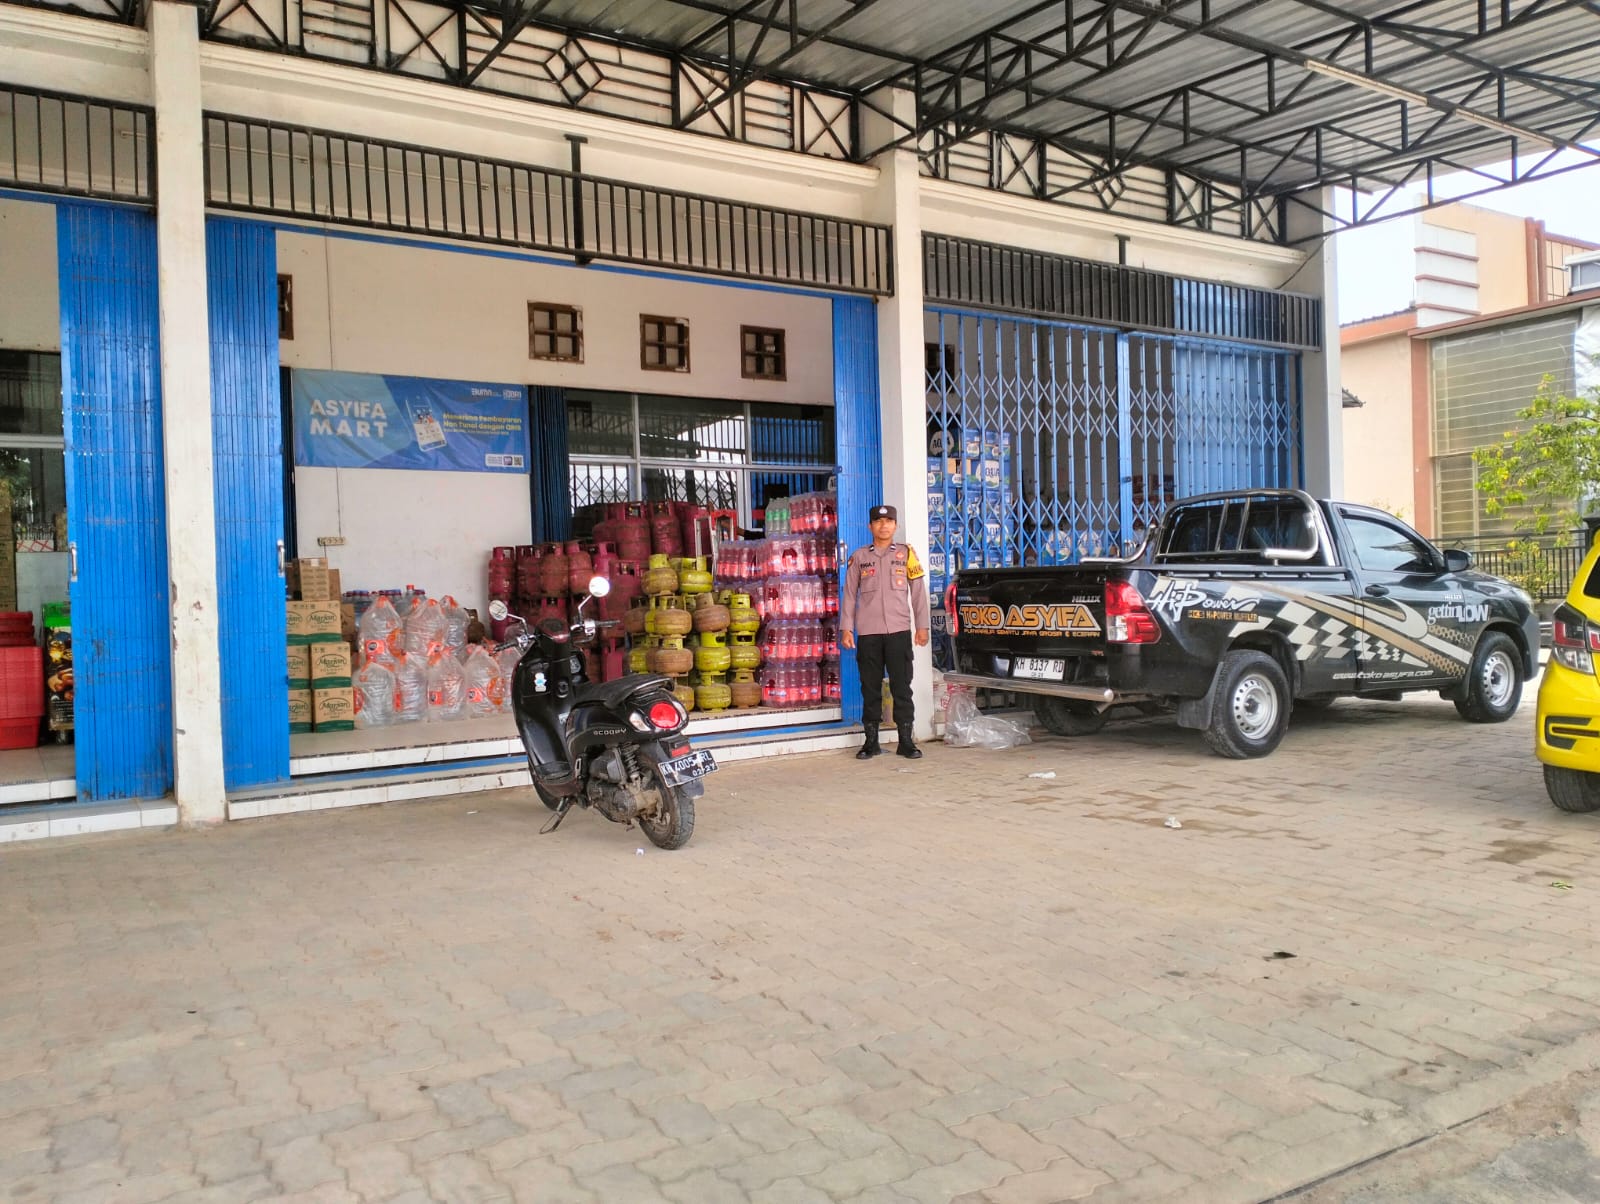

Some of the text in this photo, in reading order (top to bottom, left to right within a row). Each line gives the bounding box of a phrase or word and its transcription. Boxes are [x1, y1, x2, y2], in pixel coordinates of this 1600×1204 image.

[309, 399, 387, 419] ASYIFA
[310, 418, 388, 438] MART
[960, 604, 1099, 629] TOKO ASYIFA
[1014, 657, 1064, 673] KH 8137 RD
